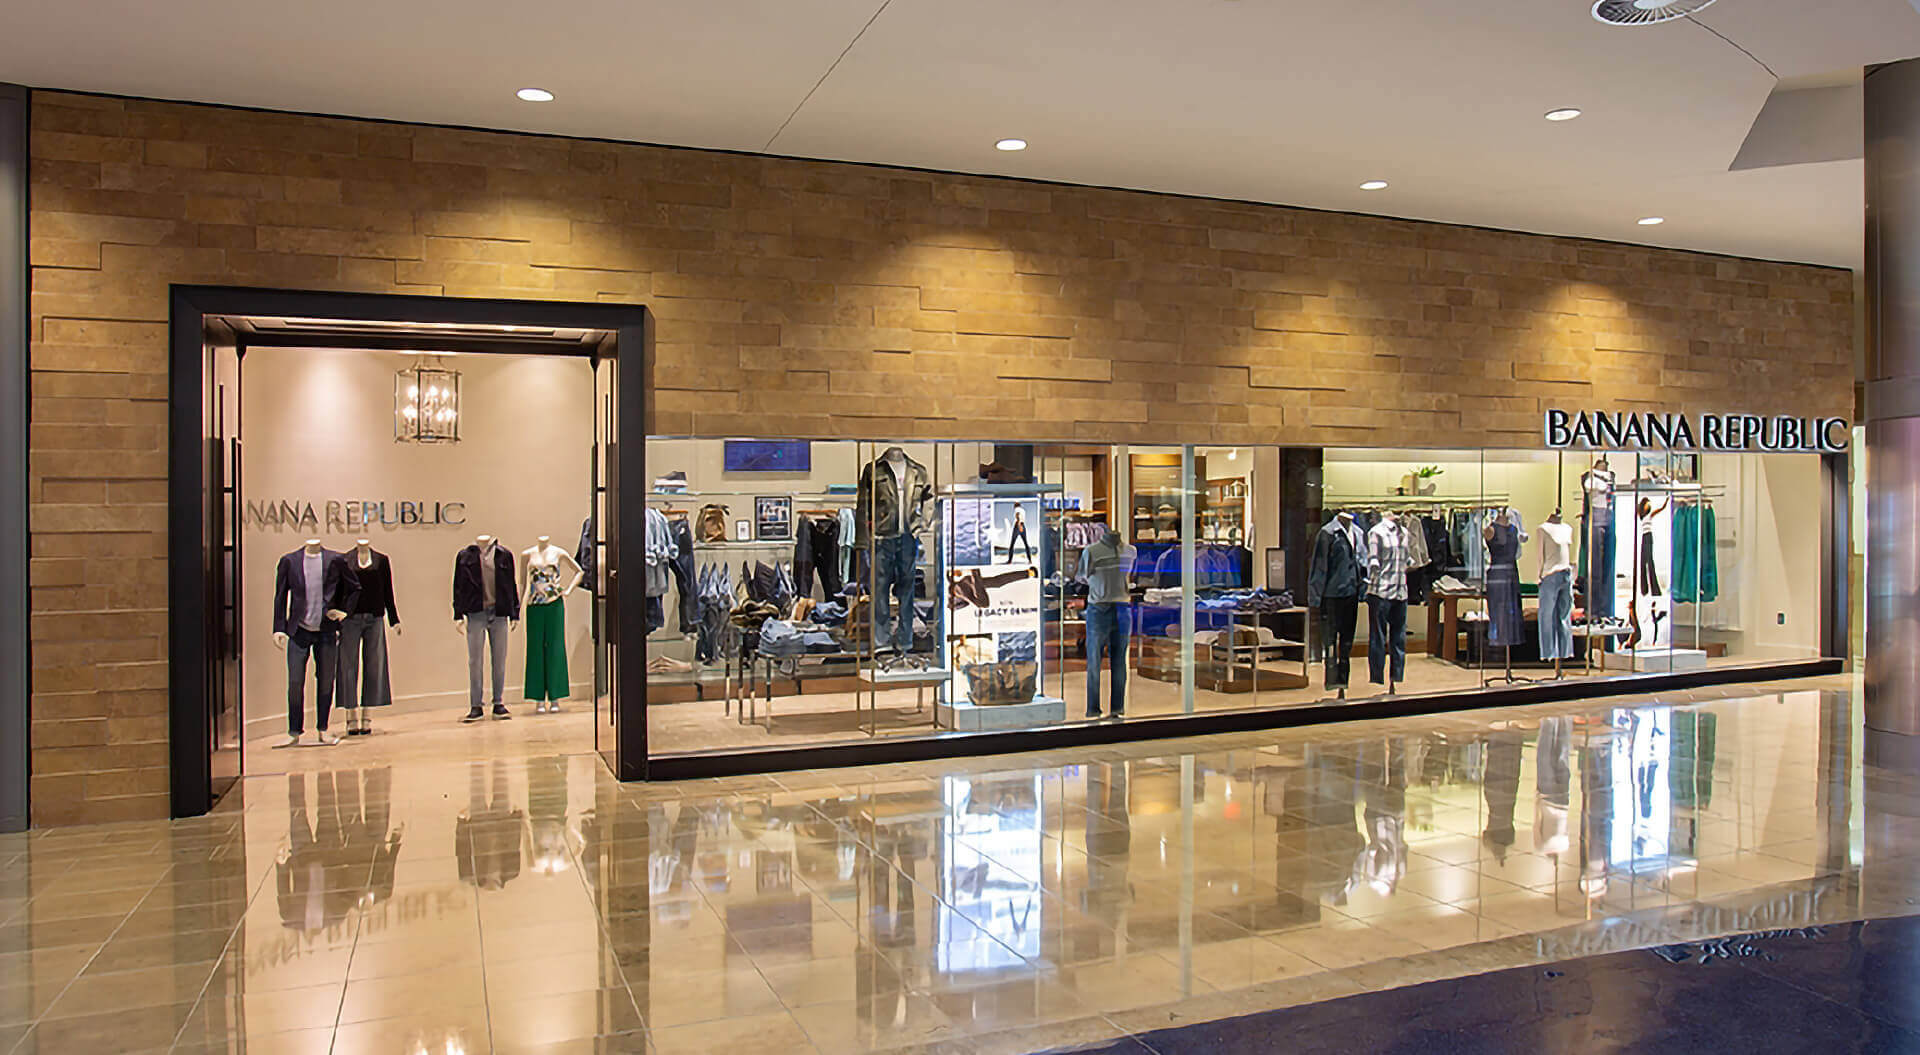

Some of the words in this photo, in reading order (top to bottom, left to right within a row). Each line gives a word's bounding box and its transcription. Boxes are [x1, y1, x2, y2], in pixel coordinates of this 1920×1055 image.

[1547, 409, 1696, 449] BANANA
[1702, 413, 1848, 450] REPUBLIC
[244, 499, 318, 525] NANA
[326, 500, 466, 526] REPUBLIC
